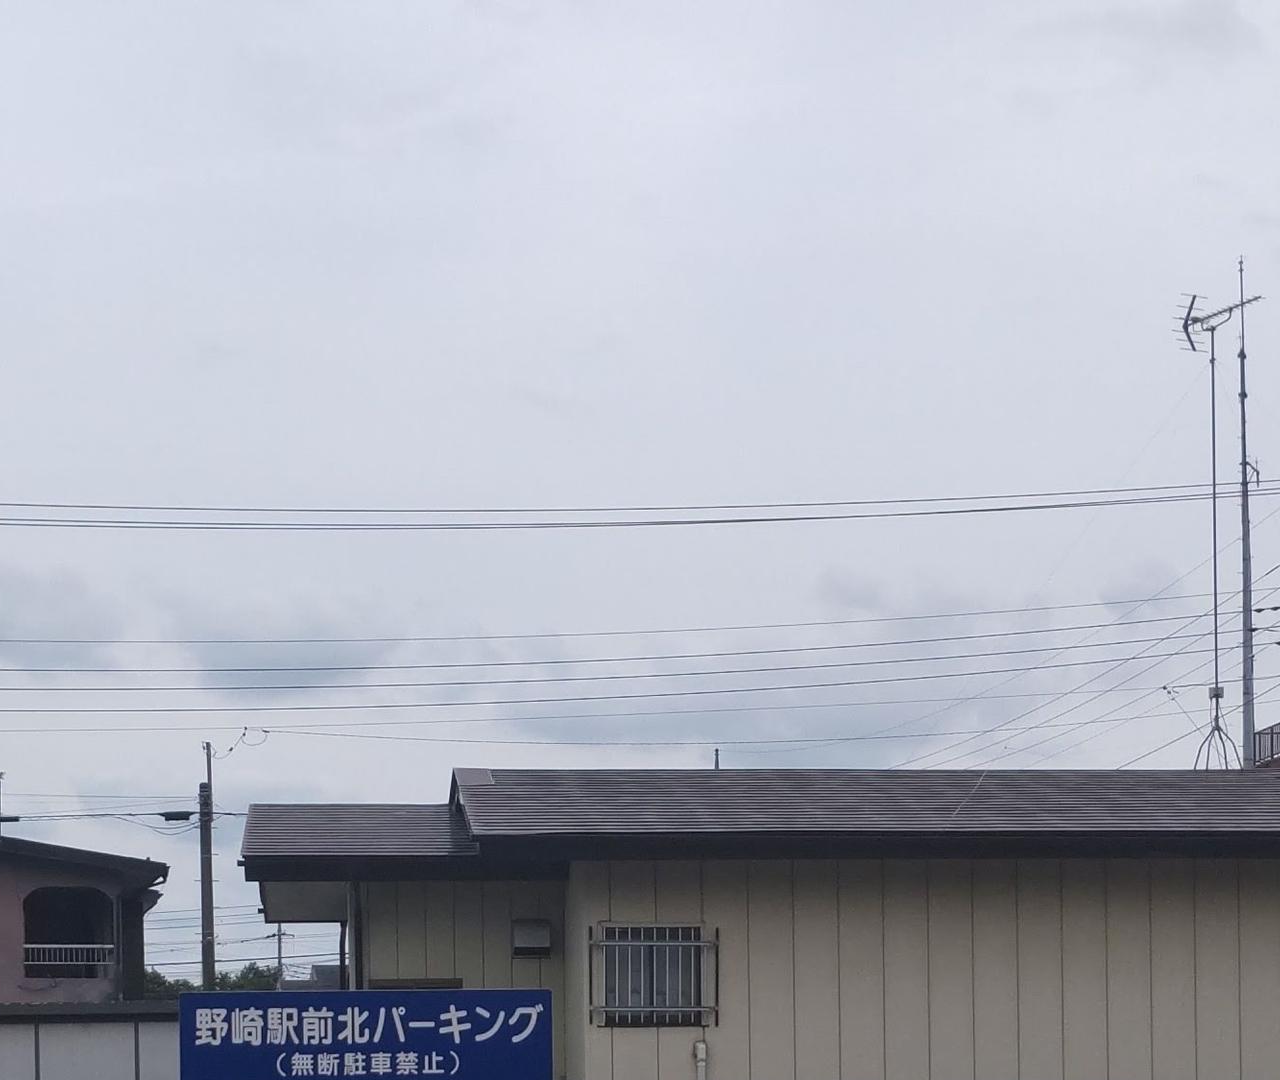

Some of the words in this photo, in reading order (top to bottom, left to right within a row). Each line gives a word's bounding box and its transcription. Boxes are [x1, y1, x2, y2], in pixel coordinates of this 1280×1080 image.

[194, 1003, 544, 1047] 野崎駅前北パーキング
[276, 1050, 461, 1077] （無断駐車禁止）
